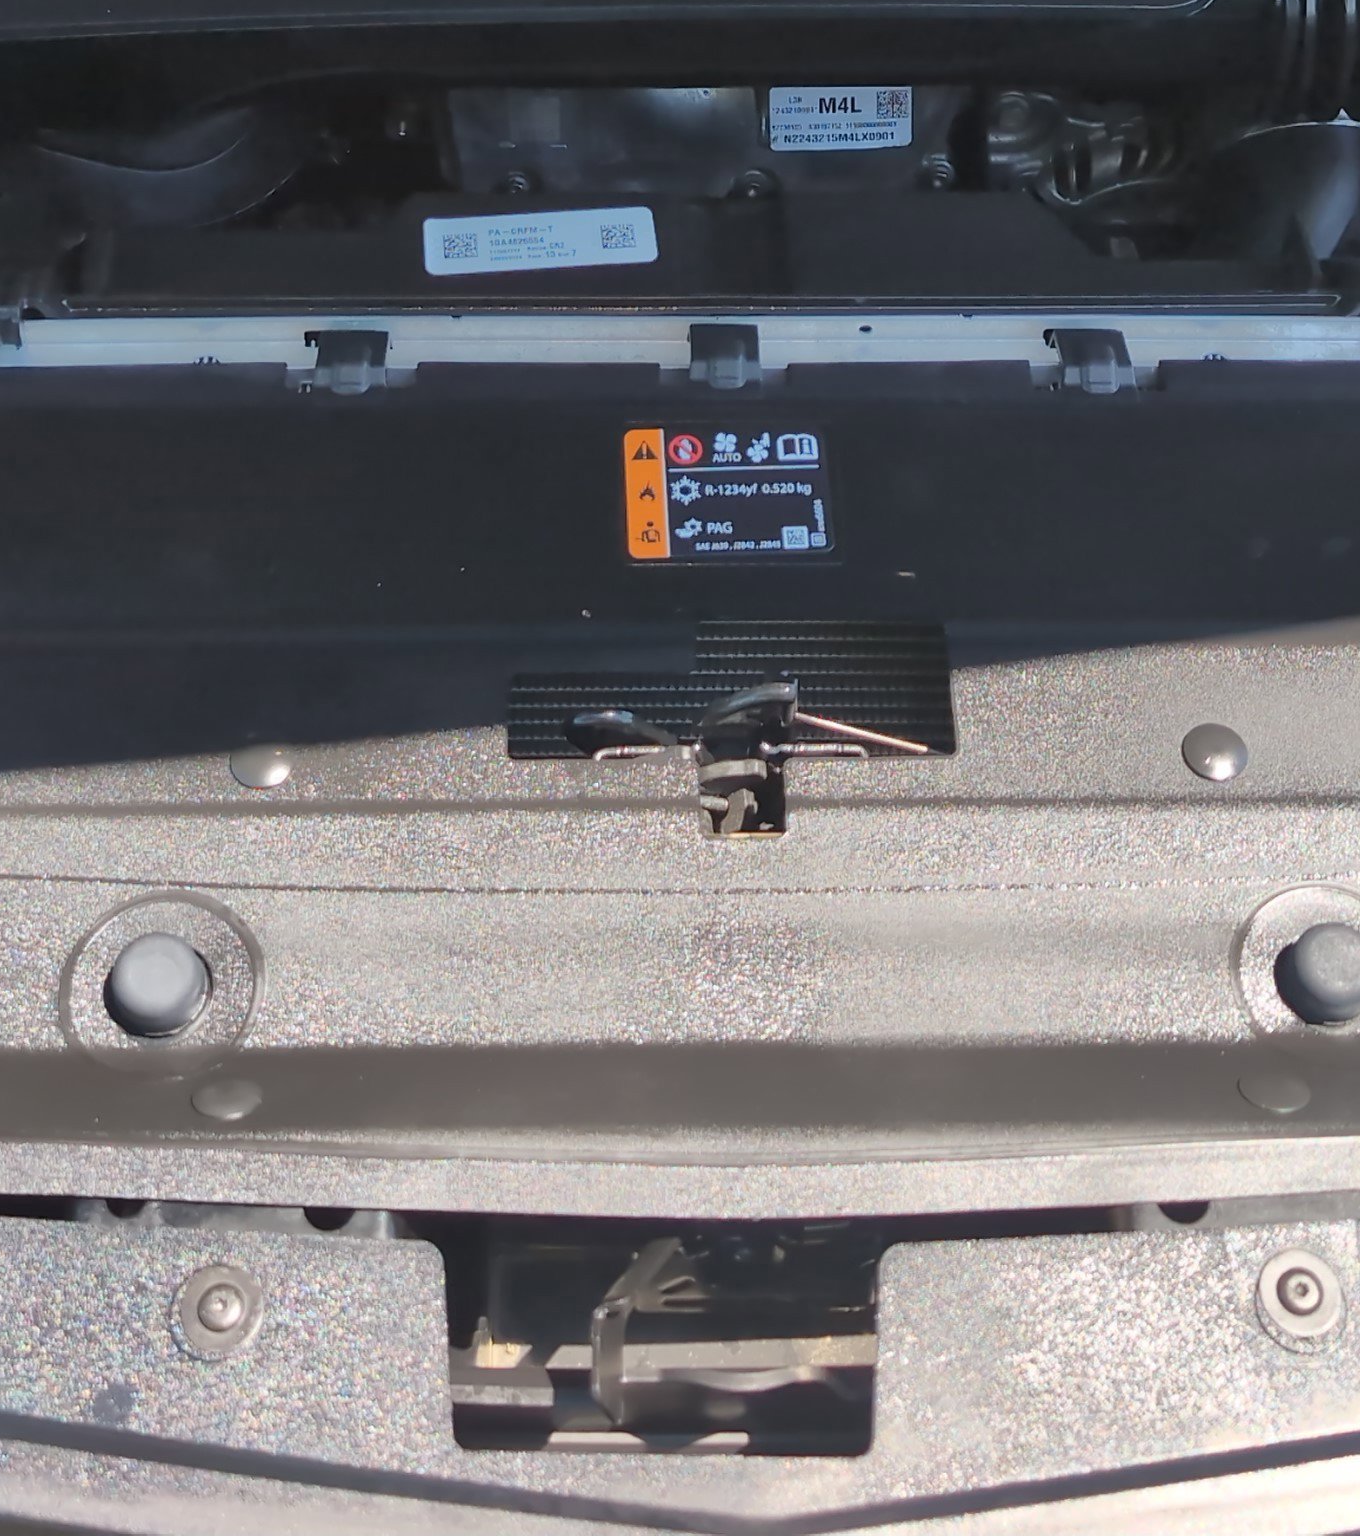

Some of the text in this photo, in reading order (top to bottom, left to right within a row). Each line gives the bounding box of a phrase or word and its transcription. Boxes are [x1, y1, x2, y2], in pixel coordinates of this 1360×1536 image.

[818, 96, 863, 114] M4L
[713, 452, 742, 463] AUTO
[704, 482, 812, 497] R-1234yf 0.520 kg
[706, 521, 733, 535] PAG
